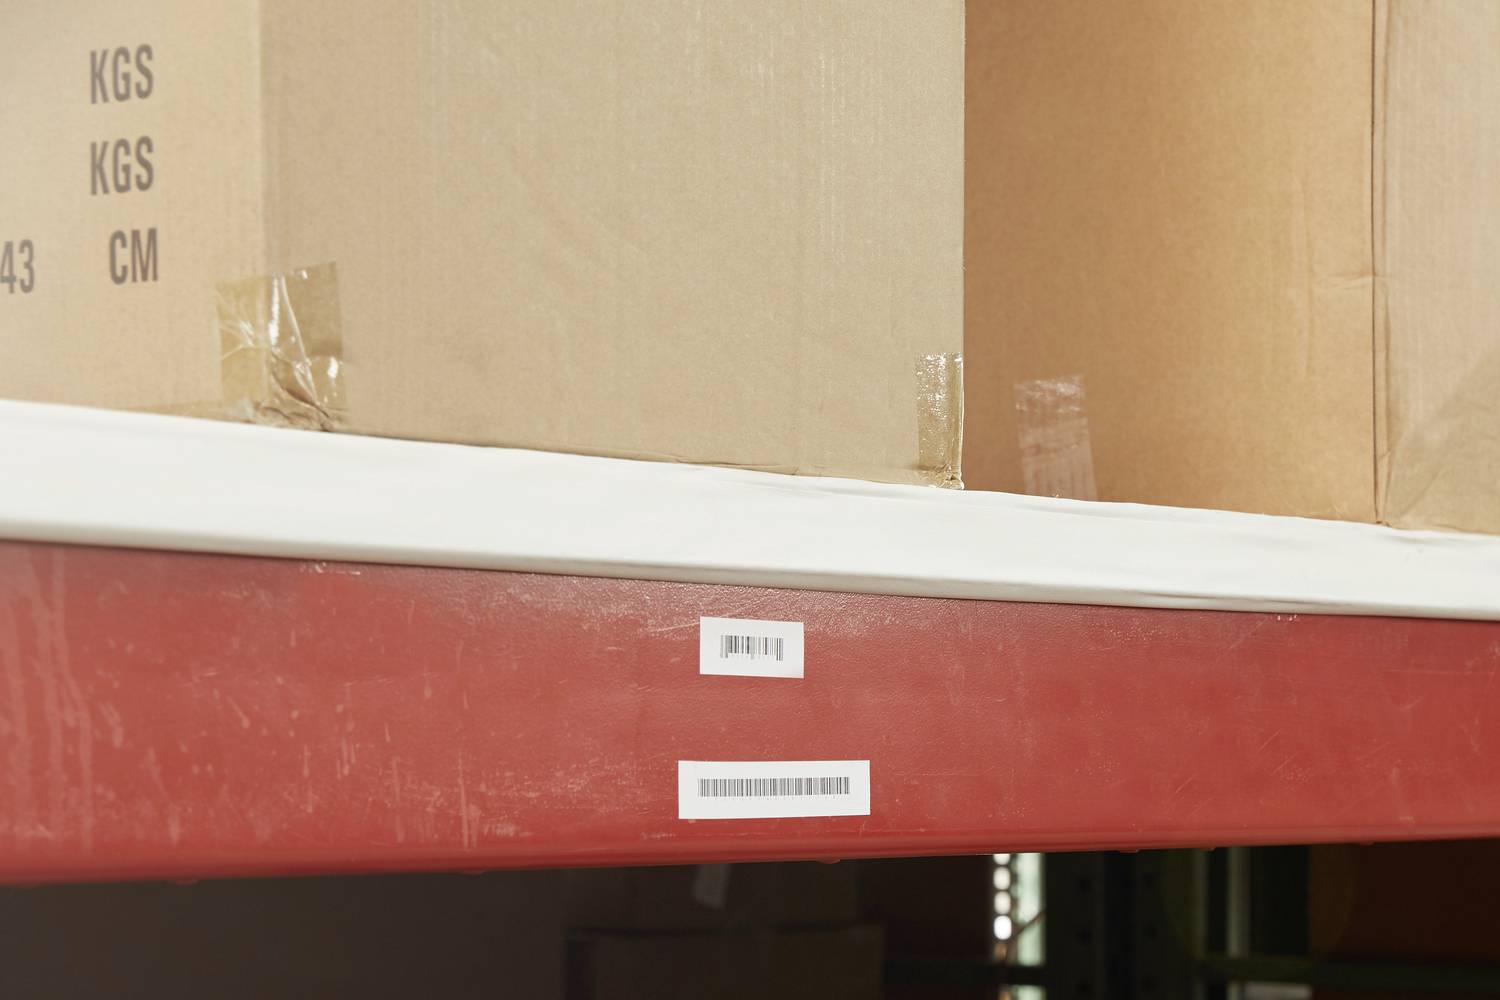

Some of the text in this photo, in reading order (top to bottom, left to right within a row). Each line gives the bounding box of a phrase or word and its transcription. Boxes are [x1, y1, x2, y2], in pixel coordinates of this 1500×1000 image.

[89, 44, 154, 104] KGS
[90, 136, 154, 196] KGS
[109, 228, 158, 285] CM
